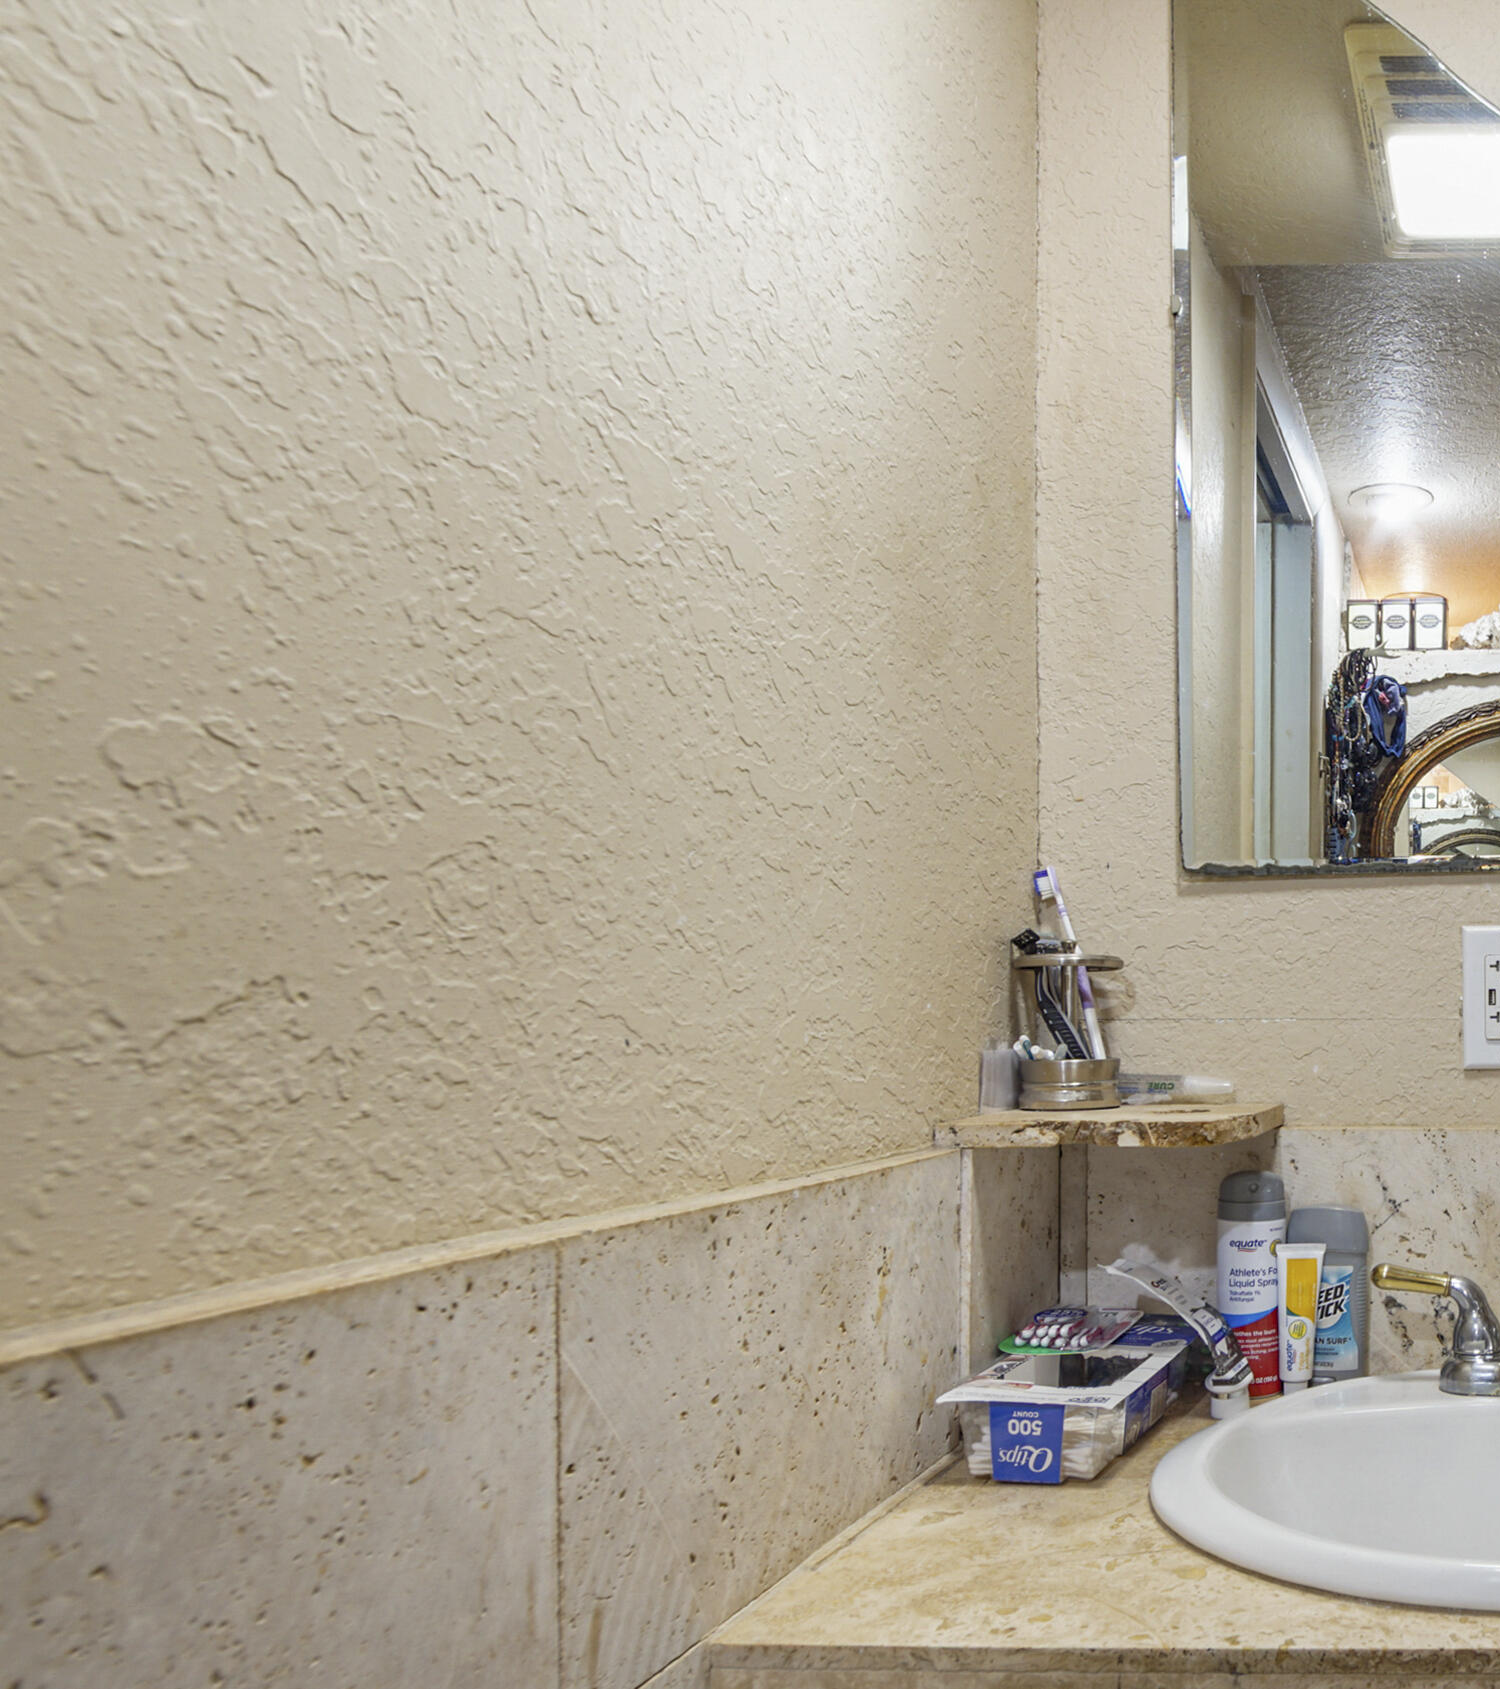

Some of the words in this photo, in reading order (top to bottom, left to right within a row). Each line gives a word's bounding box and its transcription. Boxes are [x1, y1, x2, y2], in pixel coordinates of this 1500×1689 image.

[1229, 1239, 1264, 1252] equate
[1229, 1267, 1267, 1277] Athlete's
[1268, 1266, 1278, 1275] Fo
[1229, 1279, 1256, 1289] Liquid
[1318, 1284, 1345, 1305] EED
[1316, 1298, 1346, 1320] TICK
[1326, 1337, 1349, 1345] SURF
[1008, 1419, 1043, 1436] 500
